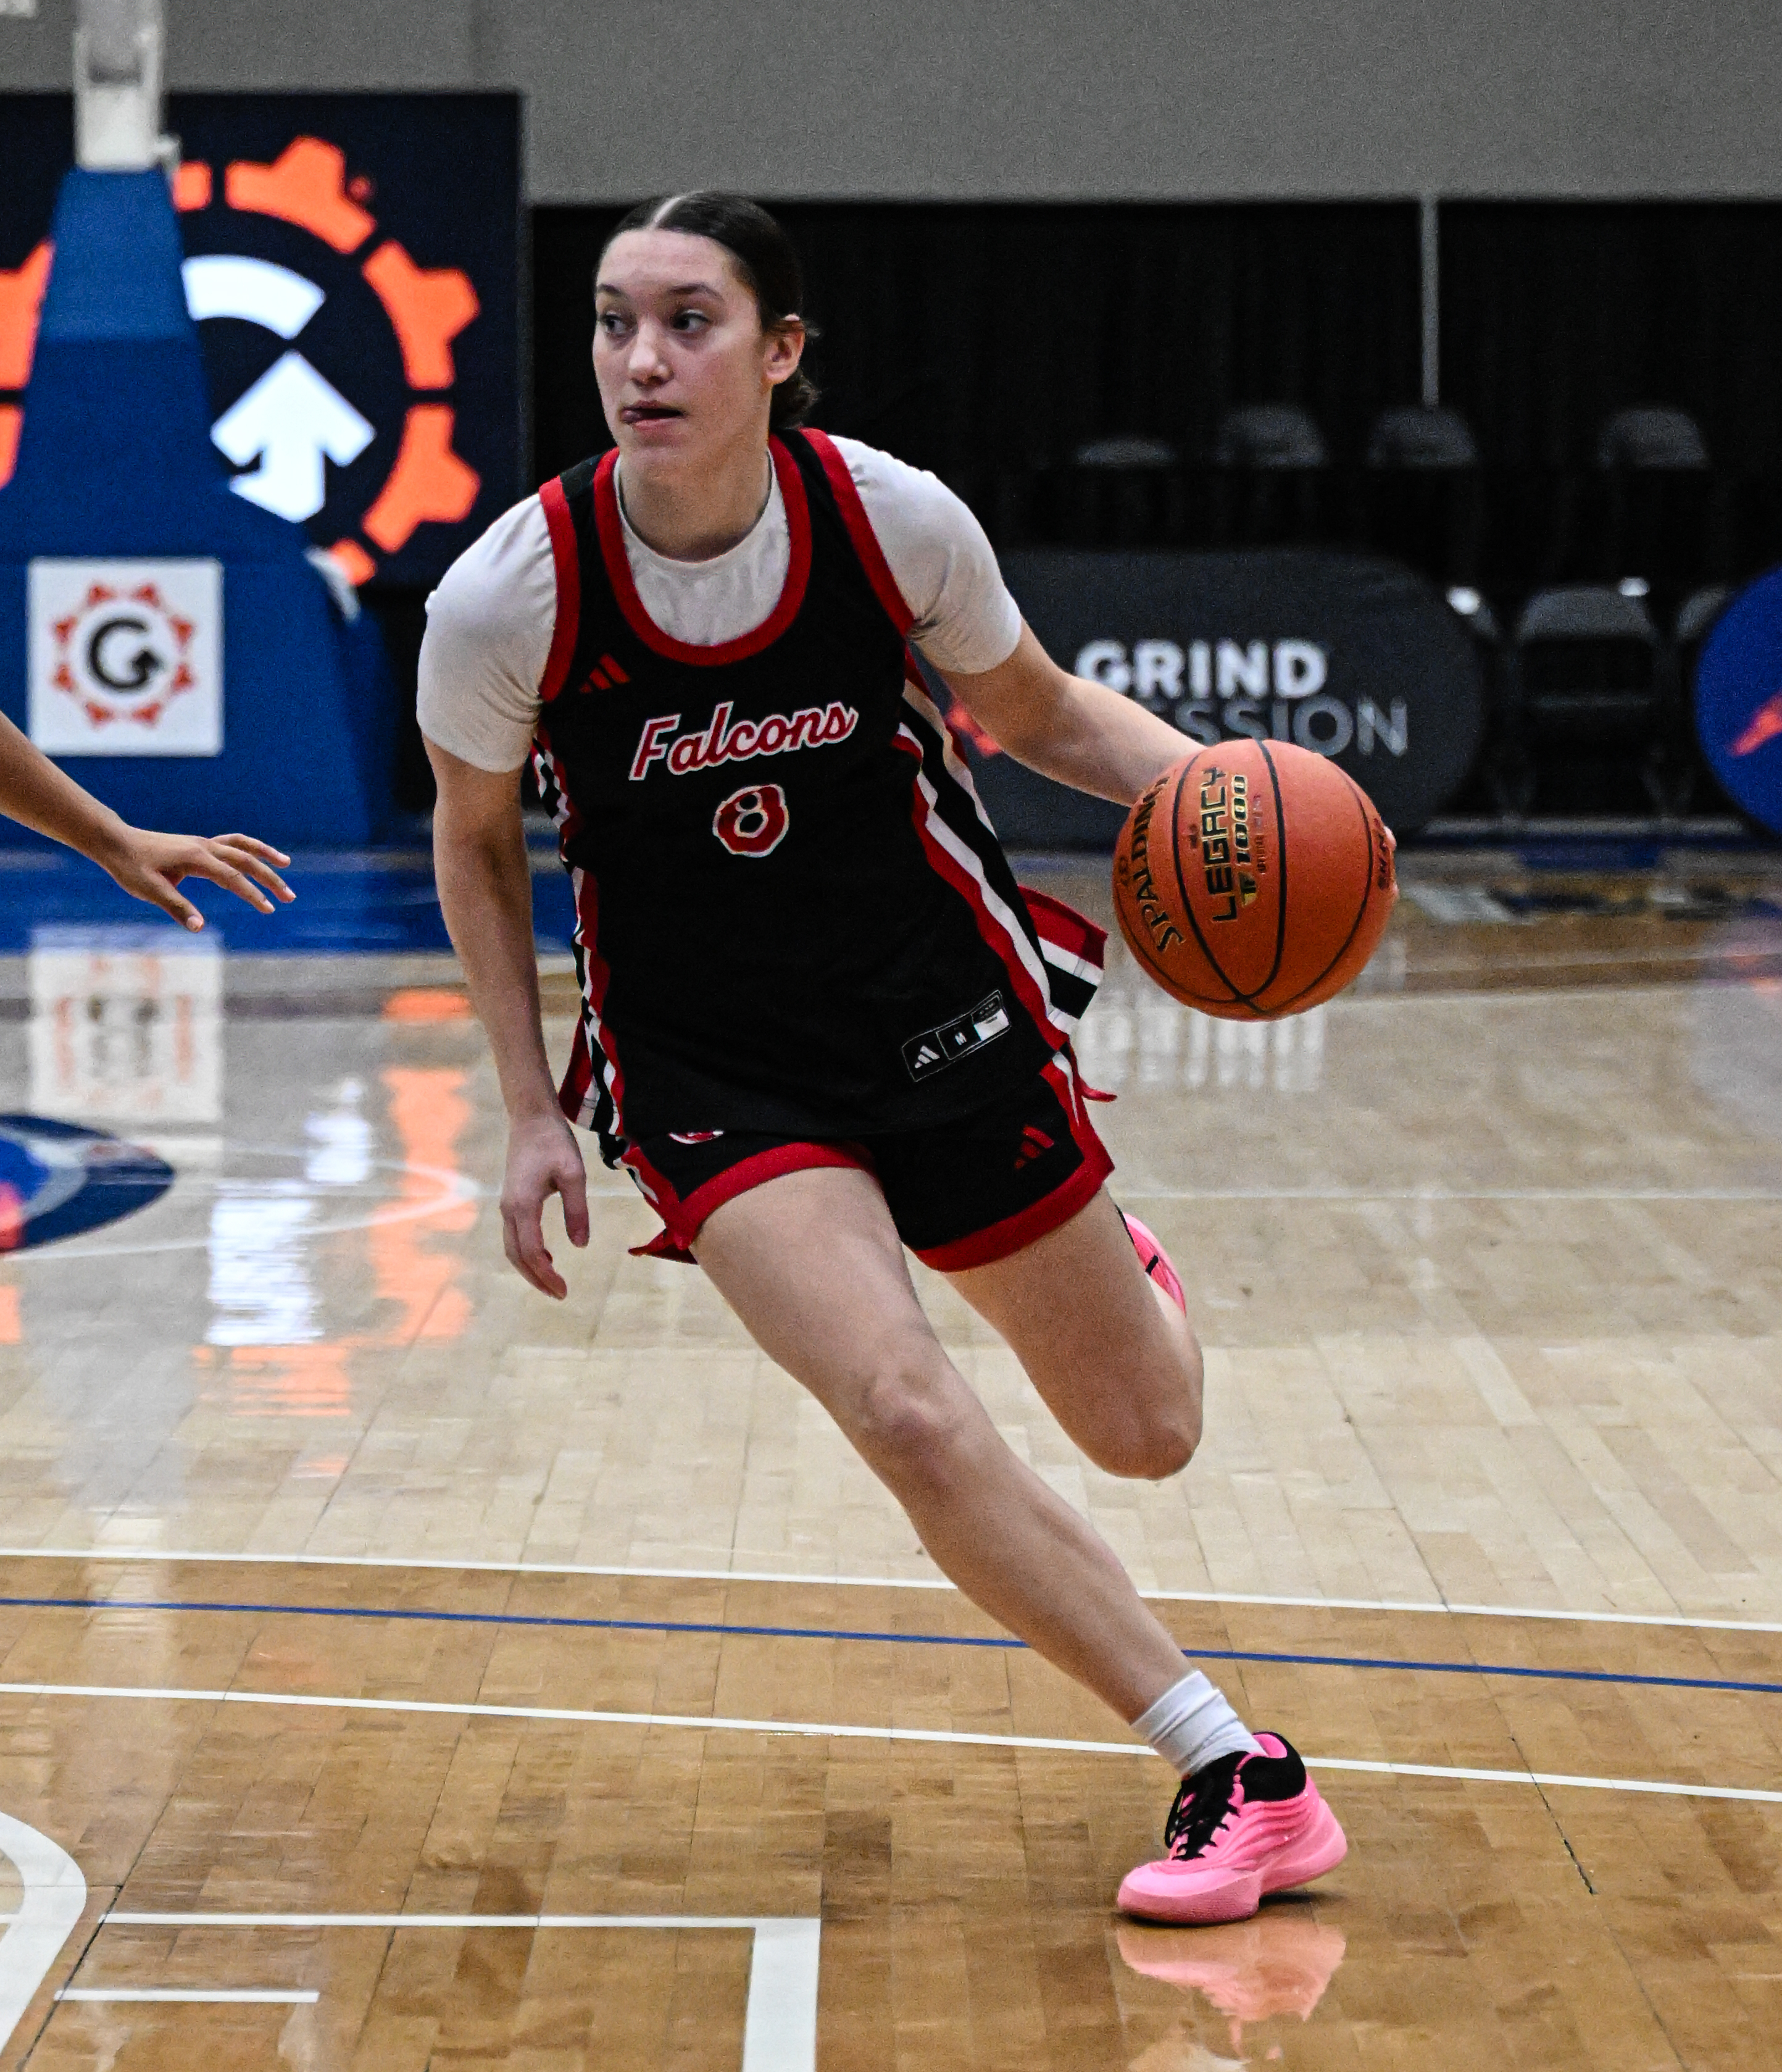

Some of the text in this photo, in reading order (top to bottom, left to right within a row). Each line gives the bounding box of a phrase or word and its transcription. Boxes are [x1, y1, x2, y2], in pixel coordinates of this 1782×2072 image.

[1075, 638, 1327, 700] GRIND
[628, 701, 859, 780] Falcons
[712, 783, 789, 858] 8
[1201, 767, 1238, 922] LEGACY
[1231, 774, 1251, 866] 1000
[955, 1032, 967, 1045] M
